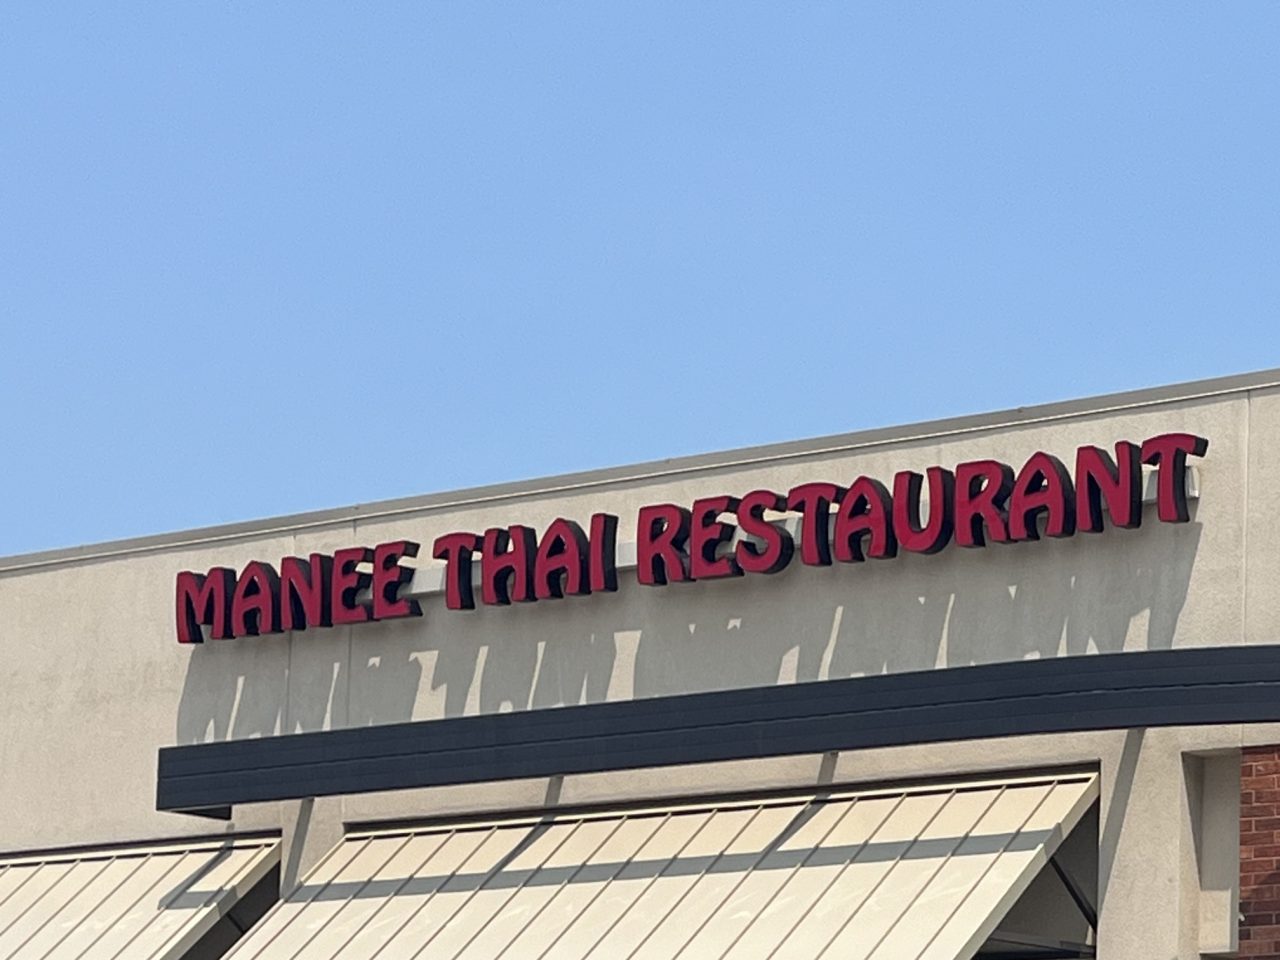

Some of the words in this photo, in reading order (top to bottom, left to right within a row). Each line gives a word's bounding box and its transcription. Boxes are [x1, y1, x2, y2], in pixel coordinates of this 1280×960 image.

[176, 540, 422, 643] MANEE
[432, 512, 618, 609] THAI
[637, 432, 1209, 585] RESTAURANT
